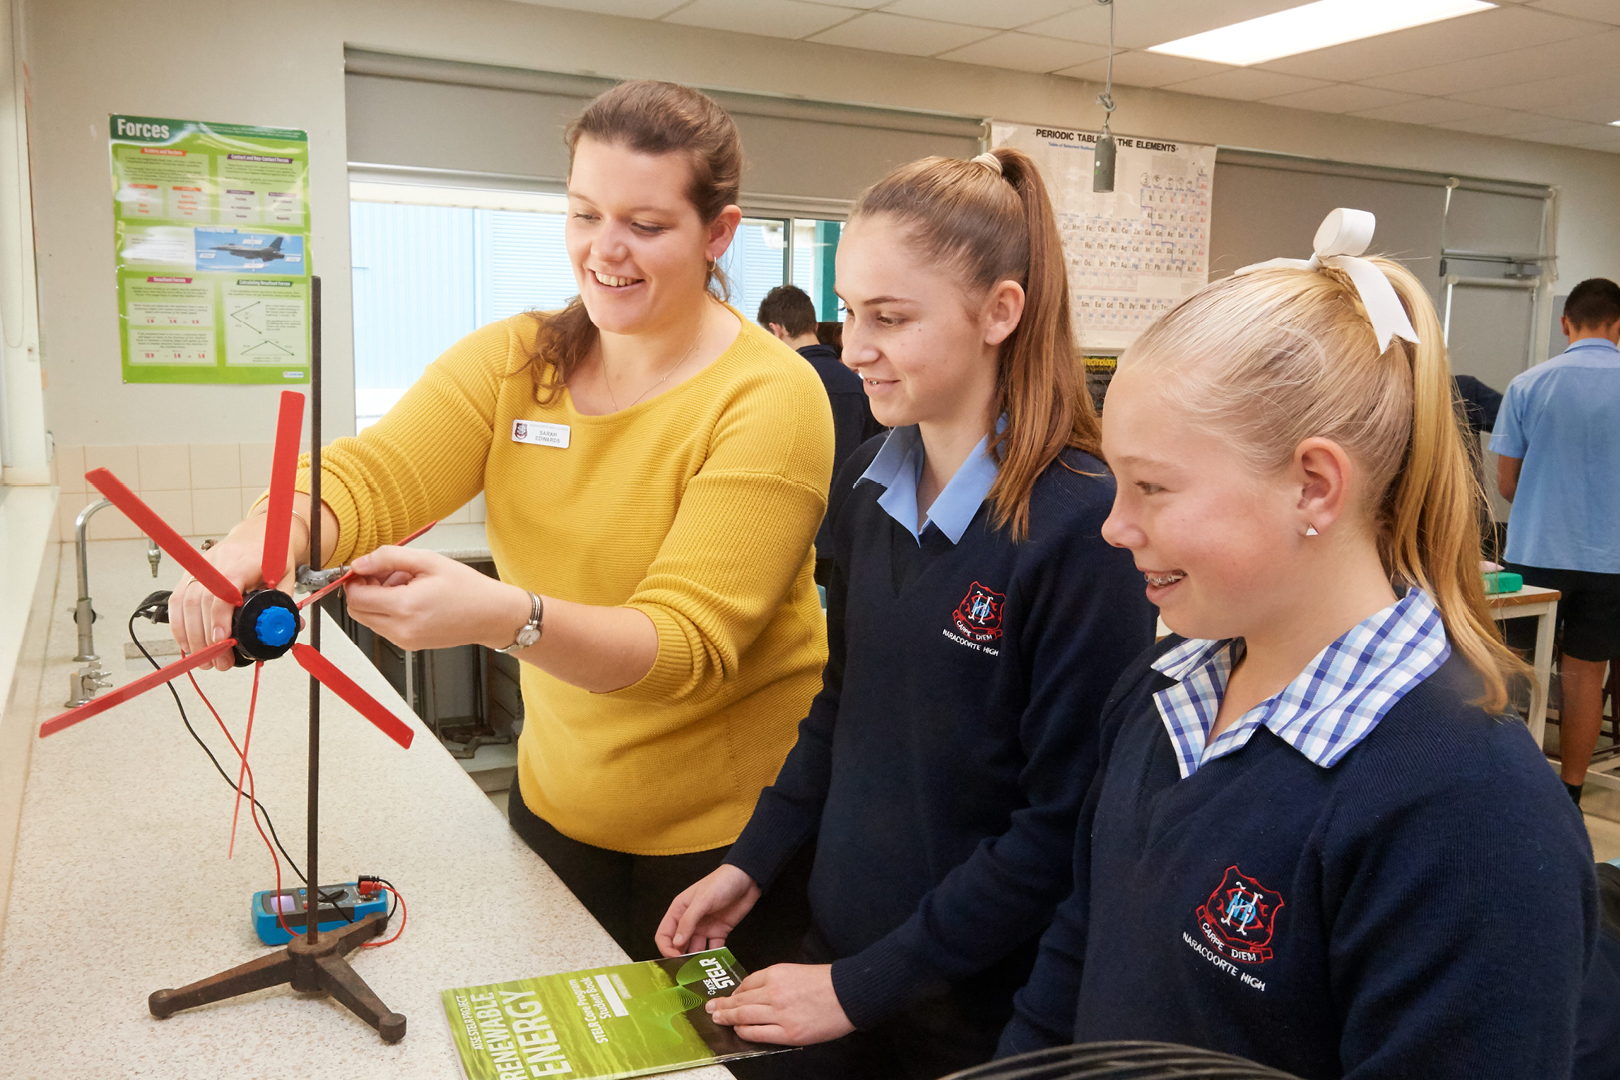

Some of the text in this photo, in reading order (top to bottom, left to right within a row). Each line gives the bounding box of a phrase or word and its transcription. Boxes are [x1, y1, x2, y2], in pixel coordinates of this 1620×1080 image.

[117, 119, 170, 139] Forces
[1036, 129, 1074, 140] PERIODIC
[1118, 138, 1133, 147] THE
[1136, 141, 1176, 152] ELEMENTS
[943, 629, 999, 656] NARACOORTE HIGH
[957, 621, 971, 636] CARPE
[1202, 922, 1256, 962] CARPE DIEM
[699, 957, 735, 989] STELR
[1182, 931, 1265, 991] NARACOORTE HIGH
[456, 995, 473, 1019] PROJECT
[568, 979, 608, 1043] STELR Core Program
[580, 976, 611, 1019] Student Book
[470, 992, 528, 1080] RENEWABLE
[499, 991, 573, 1077] ENERGY
